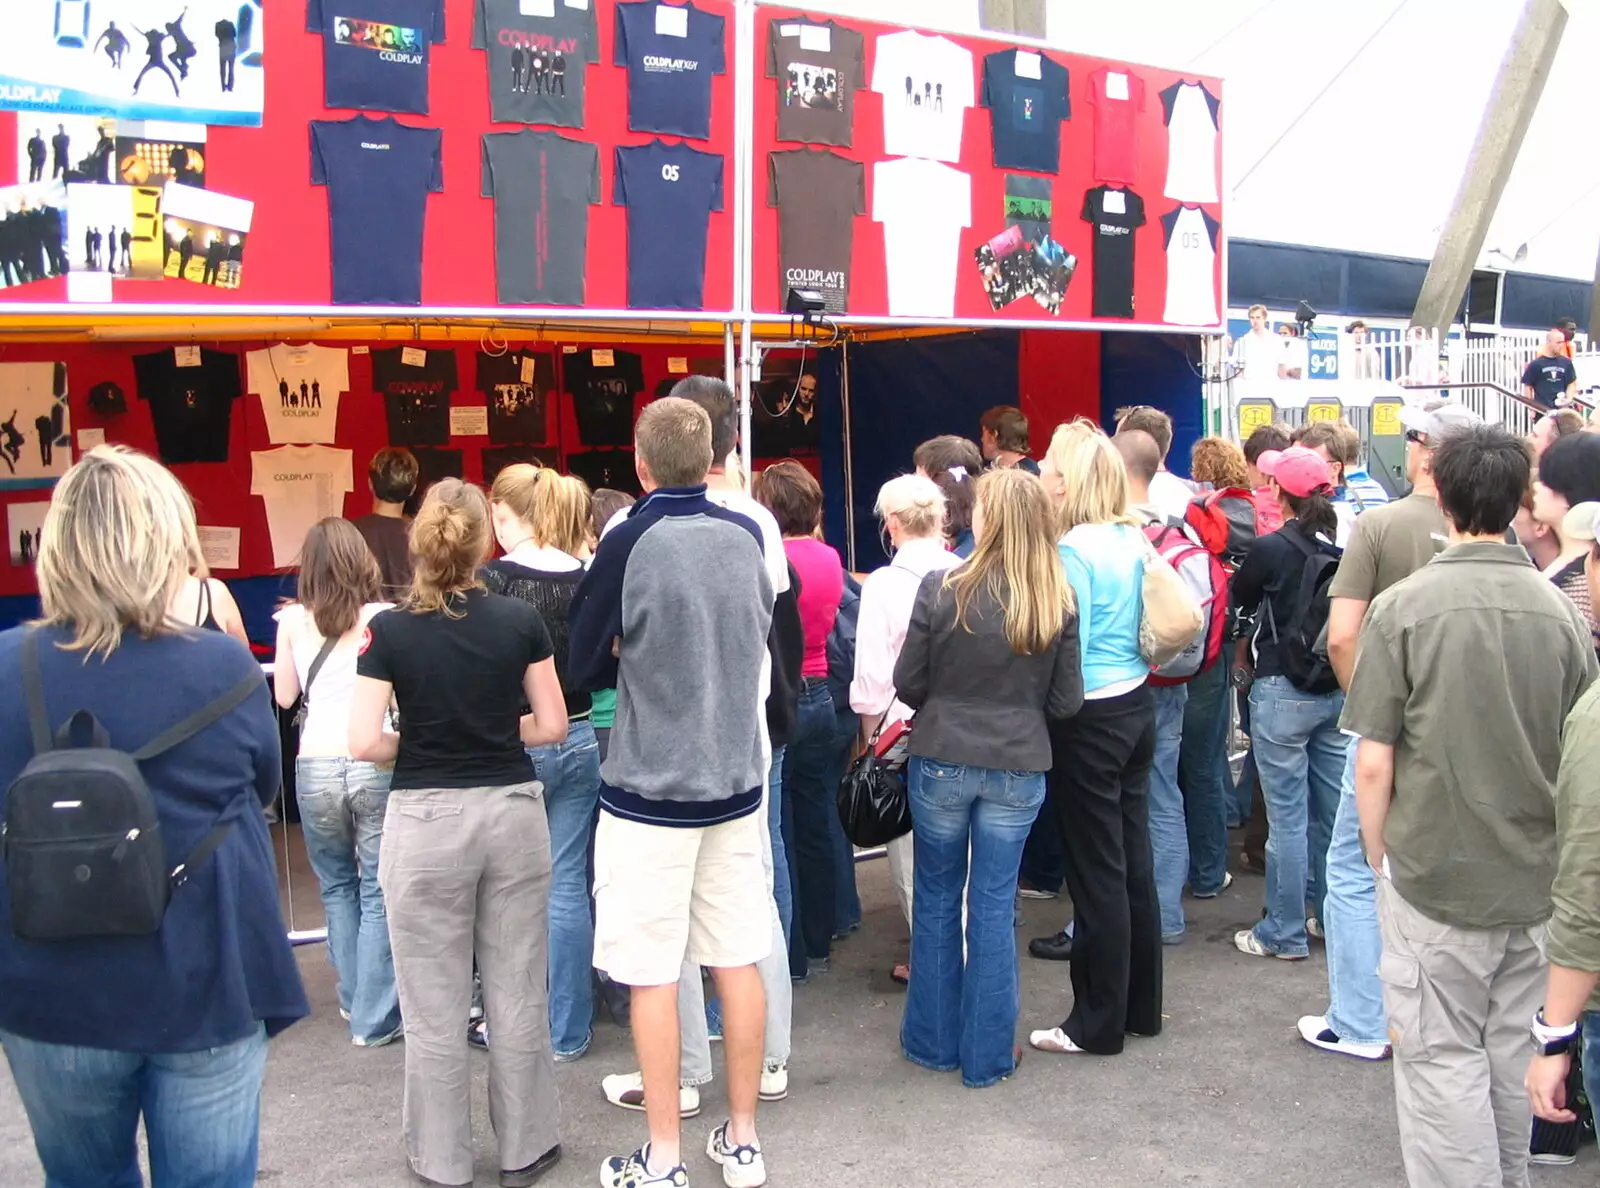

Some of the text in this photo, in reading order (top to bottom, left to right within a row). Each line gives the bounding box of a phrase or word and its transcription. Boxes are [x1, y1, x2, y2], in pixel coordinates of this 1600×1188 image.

[497, 28, 578, 54] COLDPLAY
[379, 51, 423, 64] COLDPLAY
[643, 55, 683, 68] COLDPLAY
[836, 71, 845, 113] COLDPLAY
[661, 164, 680, 182] 05
[1182, 232, 1199, 249] 05
[786, 268, 839, 283] COLDPLAY
[1311, 354, 1336, 374] 9-10
[281, 409, 320, 417] COLDPLAY
[274, 473, 314, 482] COLDPLAY
